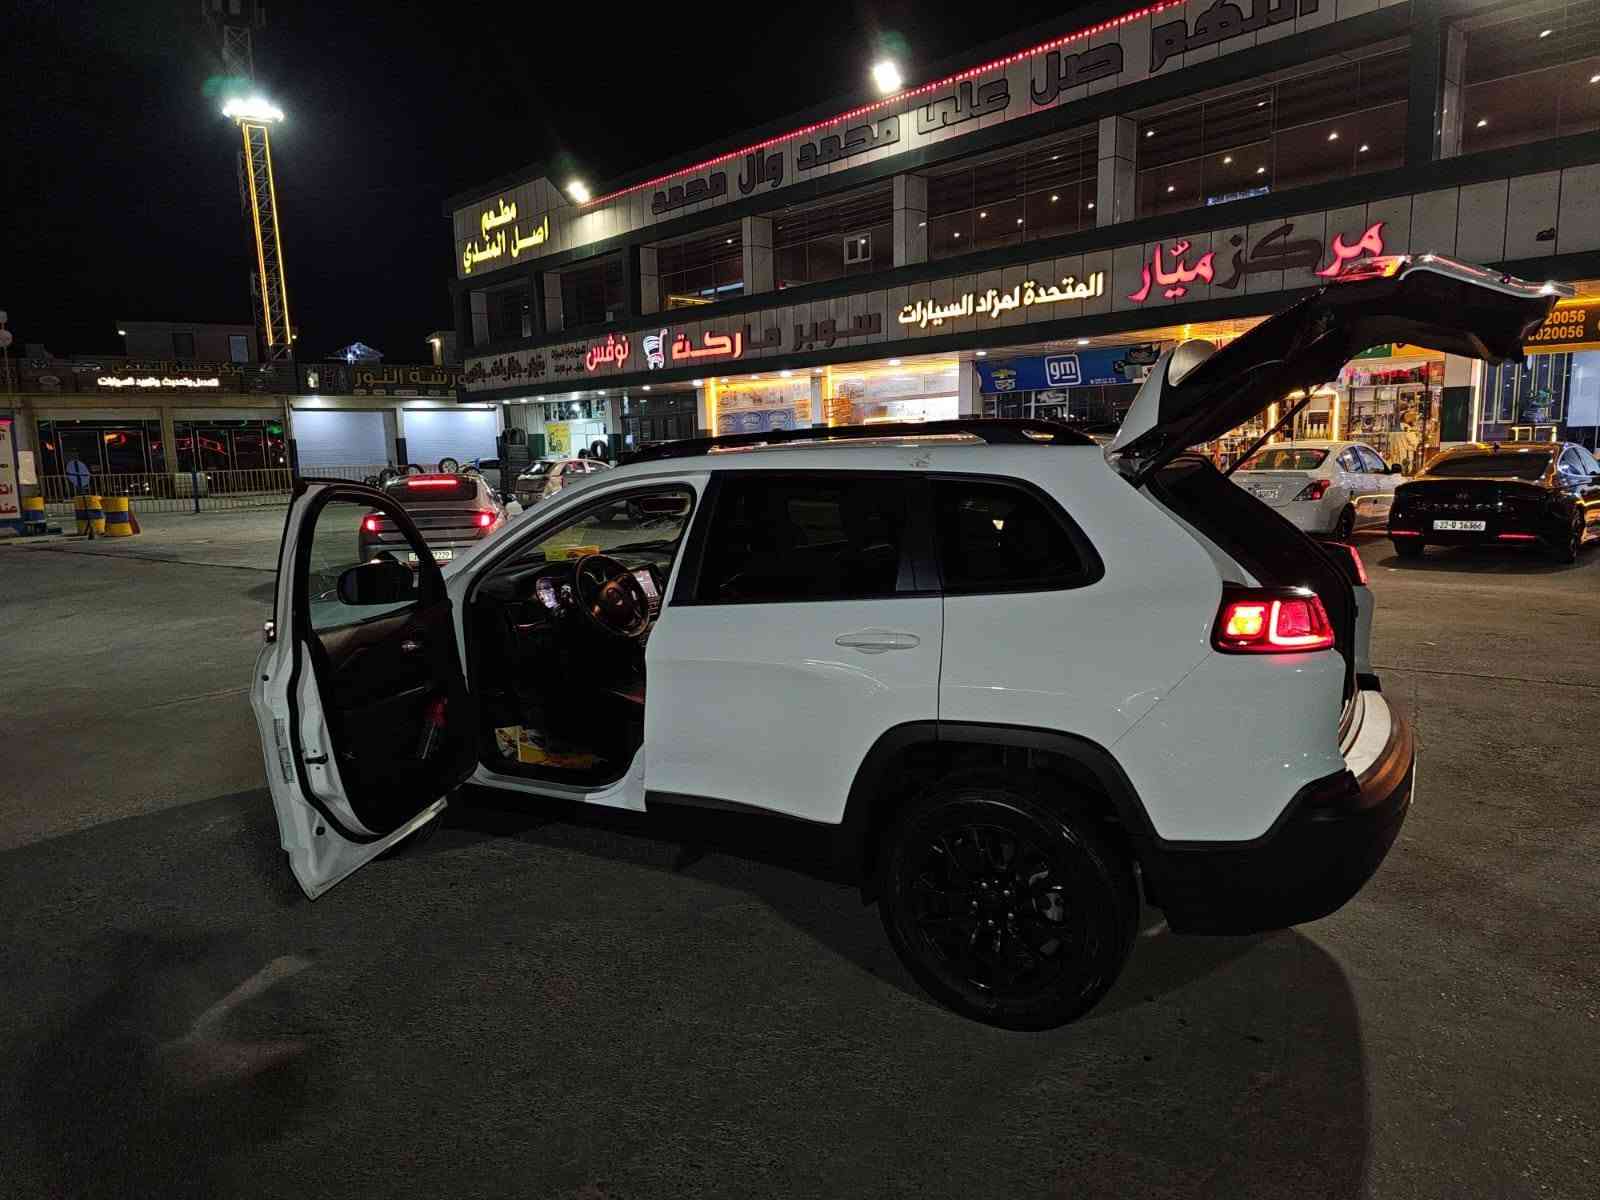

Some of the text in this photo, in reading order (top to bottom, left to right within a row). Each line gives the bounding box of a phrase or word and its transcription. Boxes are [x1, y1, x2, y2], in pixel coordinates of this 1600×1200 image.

[1031, 43, 1123, 105] صل
[917, 78, 1011, 135] على
[797, 115, 900, 171] محمد
[482, 198, 517, 242] مطعم
[652, 171, 727, 215] محمد
[463, 215, 550, 274] اصل المندي
[1216, 220, 1386, 291] مركز
[898, 271, 1104, 329] المتحدة لمزاد السيارات
[793, 313, 882, 350] سوبر
[354, 366, 403, 387] النور
[1050, 360, 1078, 380] gm
